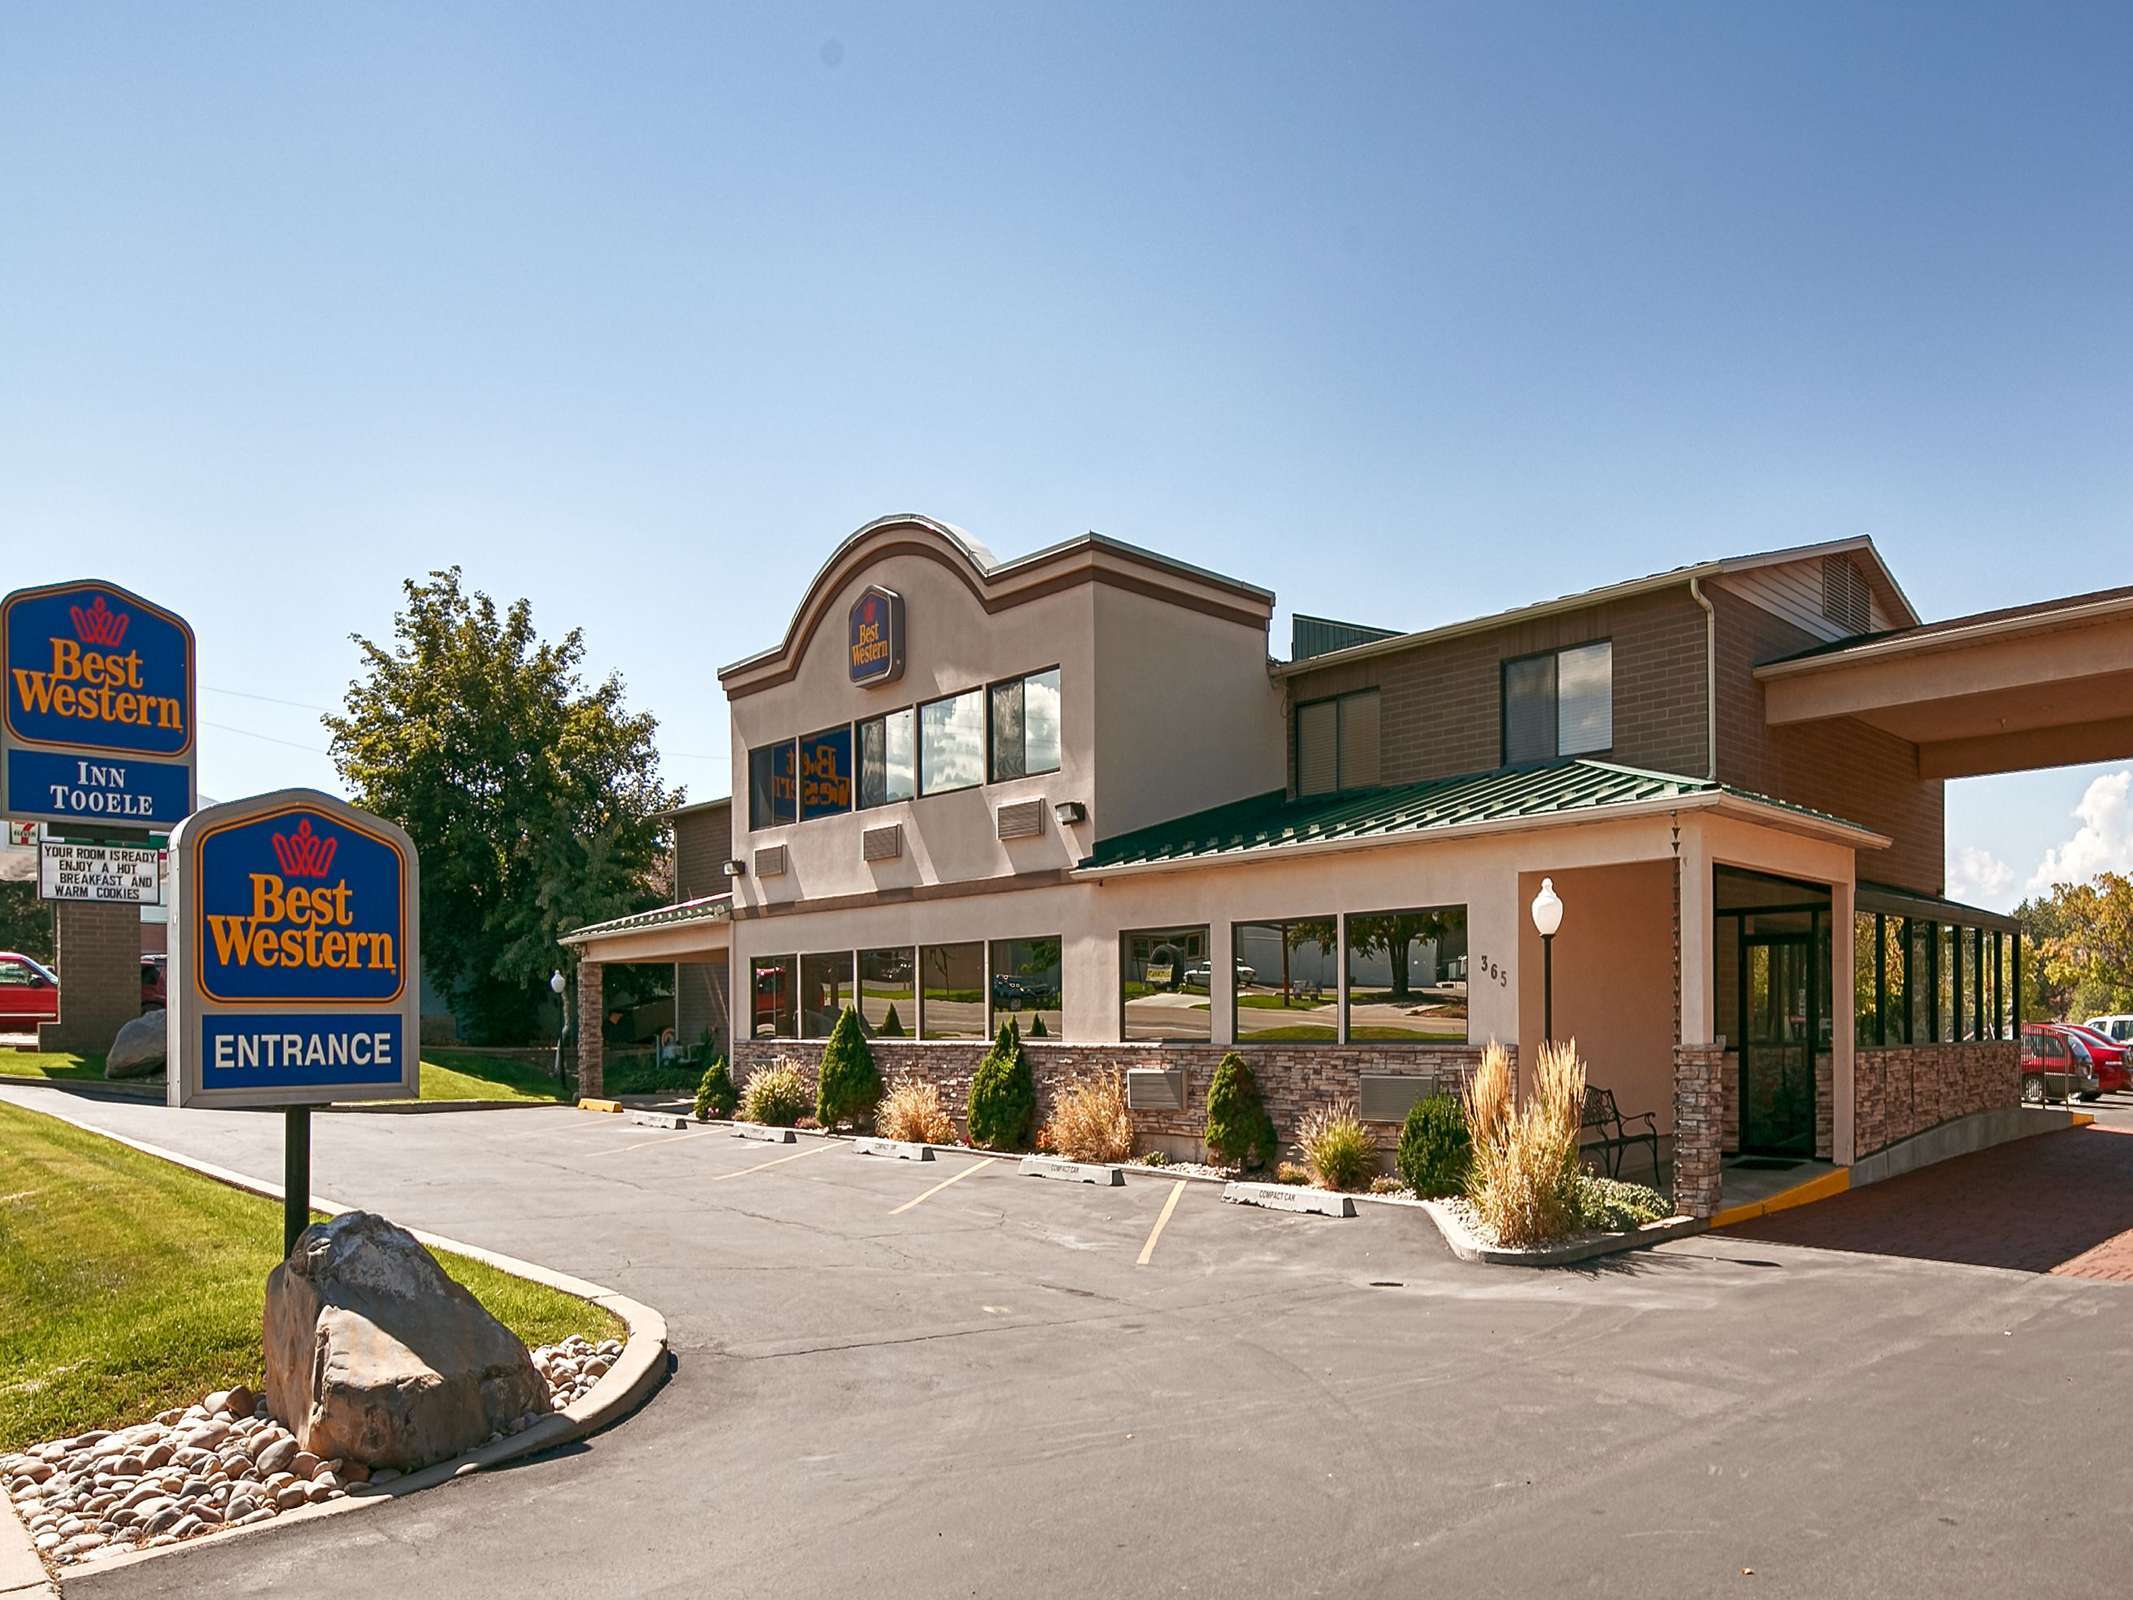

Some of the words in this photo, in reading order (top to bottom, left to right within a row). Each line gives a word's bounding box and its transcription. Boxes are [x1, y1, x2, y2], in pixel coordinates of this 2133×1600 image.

[859, 623, 879, 646] Best
[49, 637, 144, 690] Best
[852, 640, 888, 667] Western
[12, 668, 184, 731] Western
[77, 760, 126, 789] INN
[50, 785, 153, 816] TOOELE
[44, 845, 73, 859] YOUR
[76, 848, 106, 861] ROOM
[110, 850, 120, 862] IS
[121, 851, 156, 864] READY
[59, 860, 93, 873] ENJOY
[101, 863, 109, 874] A
[117, 863, 138, 875] HOT
[55, 885, 89, 898] WARM
[96, 887, 140, 900] COOKIES
[60, 873, 123, 887] BREAKFAST
[131, 876, 153, 888] AND
[249, 873, 353, 927] Best
[207, 910, 397, 970] Western
[1480, 954, 1508, 989] 365
[215, 1032, 392, 1068] ENTRANCE
[1258, 1189, 1284, 1200] COMPACT
[1284, 1193, 1297, 1201] CAR
